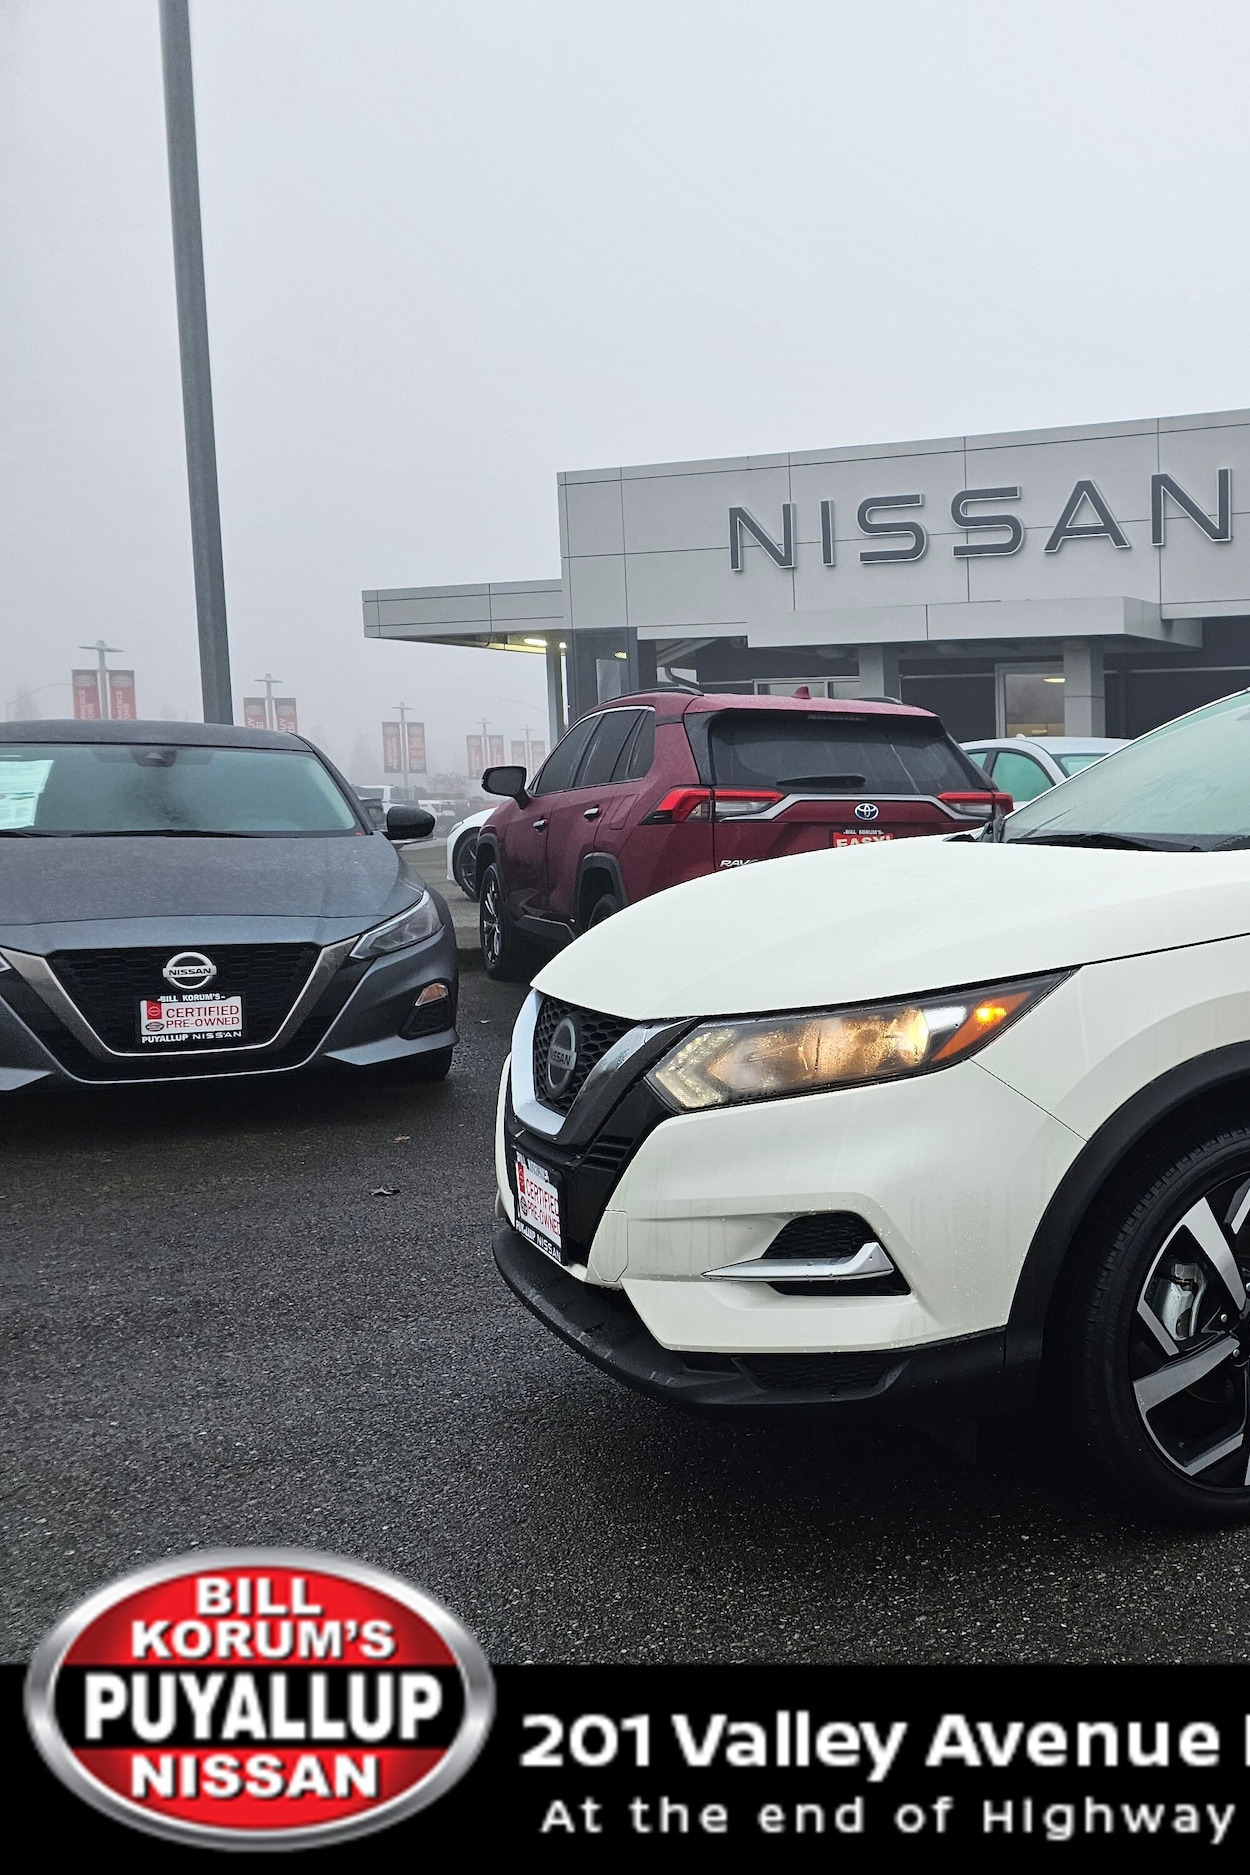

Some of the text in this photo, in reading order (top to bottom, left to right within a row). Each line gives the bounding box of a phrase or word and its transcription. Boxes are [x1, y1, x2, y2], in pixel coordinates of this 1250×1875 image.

[728, 467, 1234, 571] NISSAN
[720, 859, 758, 868] RAV
[168, 967, 211, 976] NISSAN
[160, 993, 220, 1003] BILL KORUM'S
[166, 1005, 239, 1019] CERTIFIED
[166, 1017, 240, 1028] PRE-OWNED
[141, 1031, 242, 1043] PUYALLUP NISSAN
[526, 1179, 560, 1216] CERTIFIED
[527, 1200, 561, 1236] PRE-OWNED
[536, 1233, 561, 1262] NISSAN
